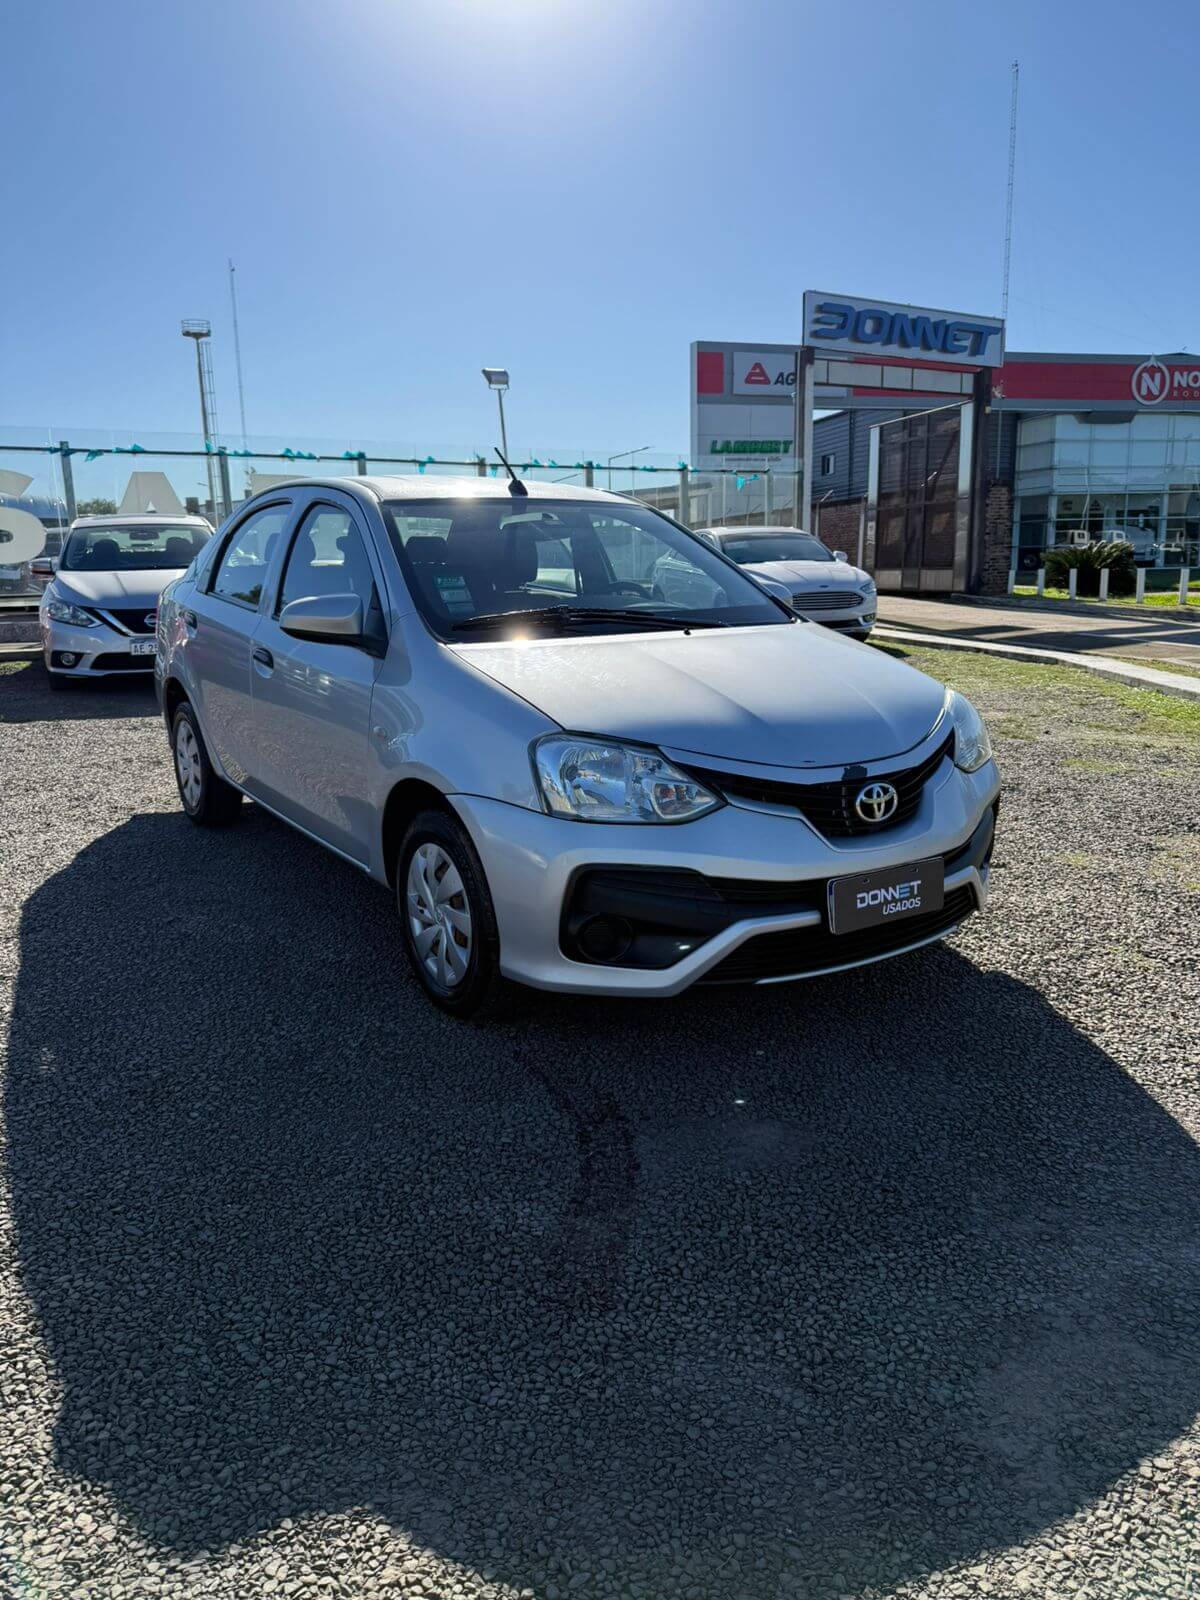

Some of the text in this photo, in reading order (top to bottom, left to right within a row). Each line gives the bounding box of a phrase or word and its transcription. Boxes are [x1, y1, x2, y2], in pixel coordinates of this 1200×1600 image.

[810, 302, 1002, 357] DONNET
[856, 880, 922, 909] DONNET
[882, 897, 921, 916] USADOS
